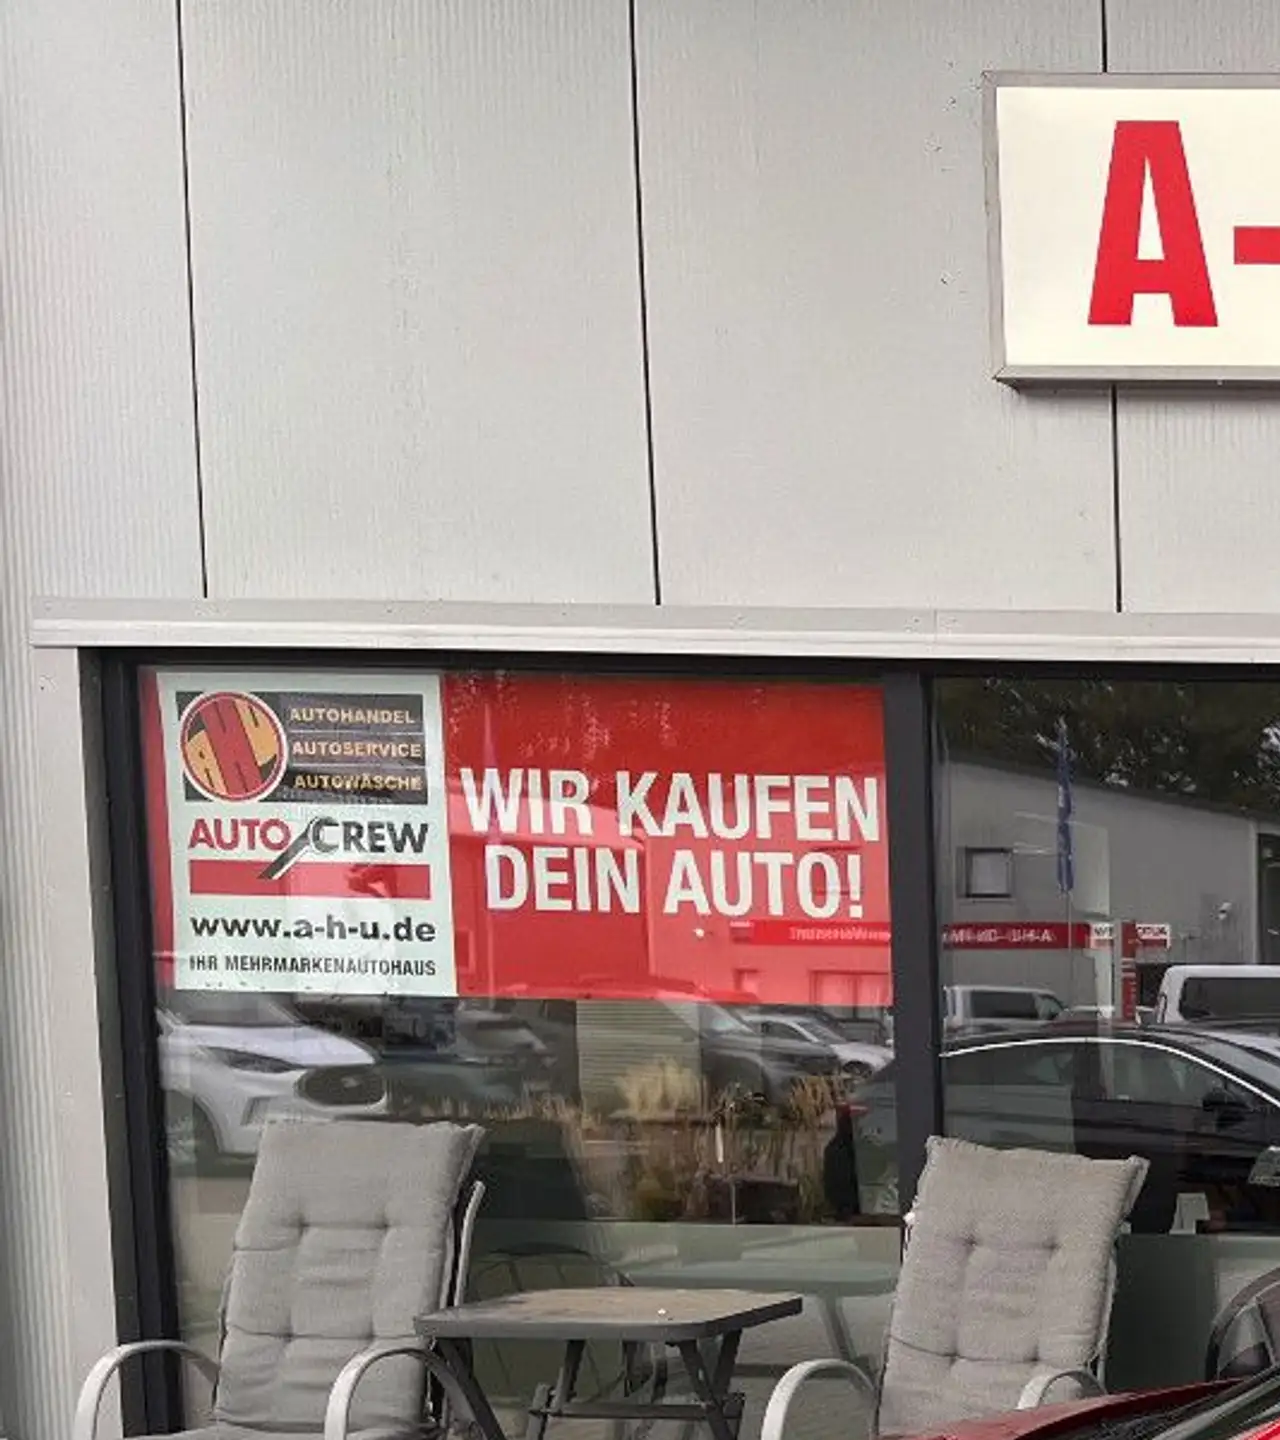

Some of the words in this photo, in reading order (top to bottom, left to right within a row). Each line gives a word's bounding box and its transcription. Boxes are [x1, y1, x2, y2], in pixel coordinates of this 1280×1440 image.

[289, 707, 415, 725] AUTOHANDEL
[292, 740, 422, 759] AUTOSERVICE
[293, 772, 423, 792] AUTOWÄSCHE
[459, 766, 594, 836] WIR
[615, 770, 880, 843] KAUFEN
[188, 818, 292, 851] AUTO
[311, 815, 429, 854] CREW
[484, 843, 641, 914] DEIN
[663, 848, 864, 919] AUTO!
[189, 913, 437, 943] www.a-h-u.de
[189, 955, 218, 971] IHR
[225, 955, 437, 977] MEHRMARKENAUTOHAUS
